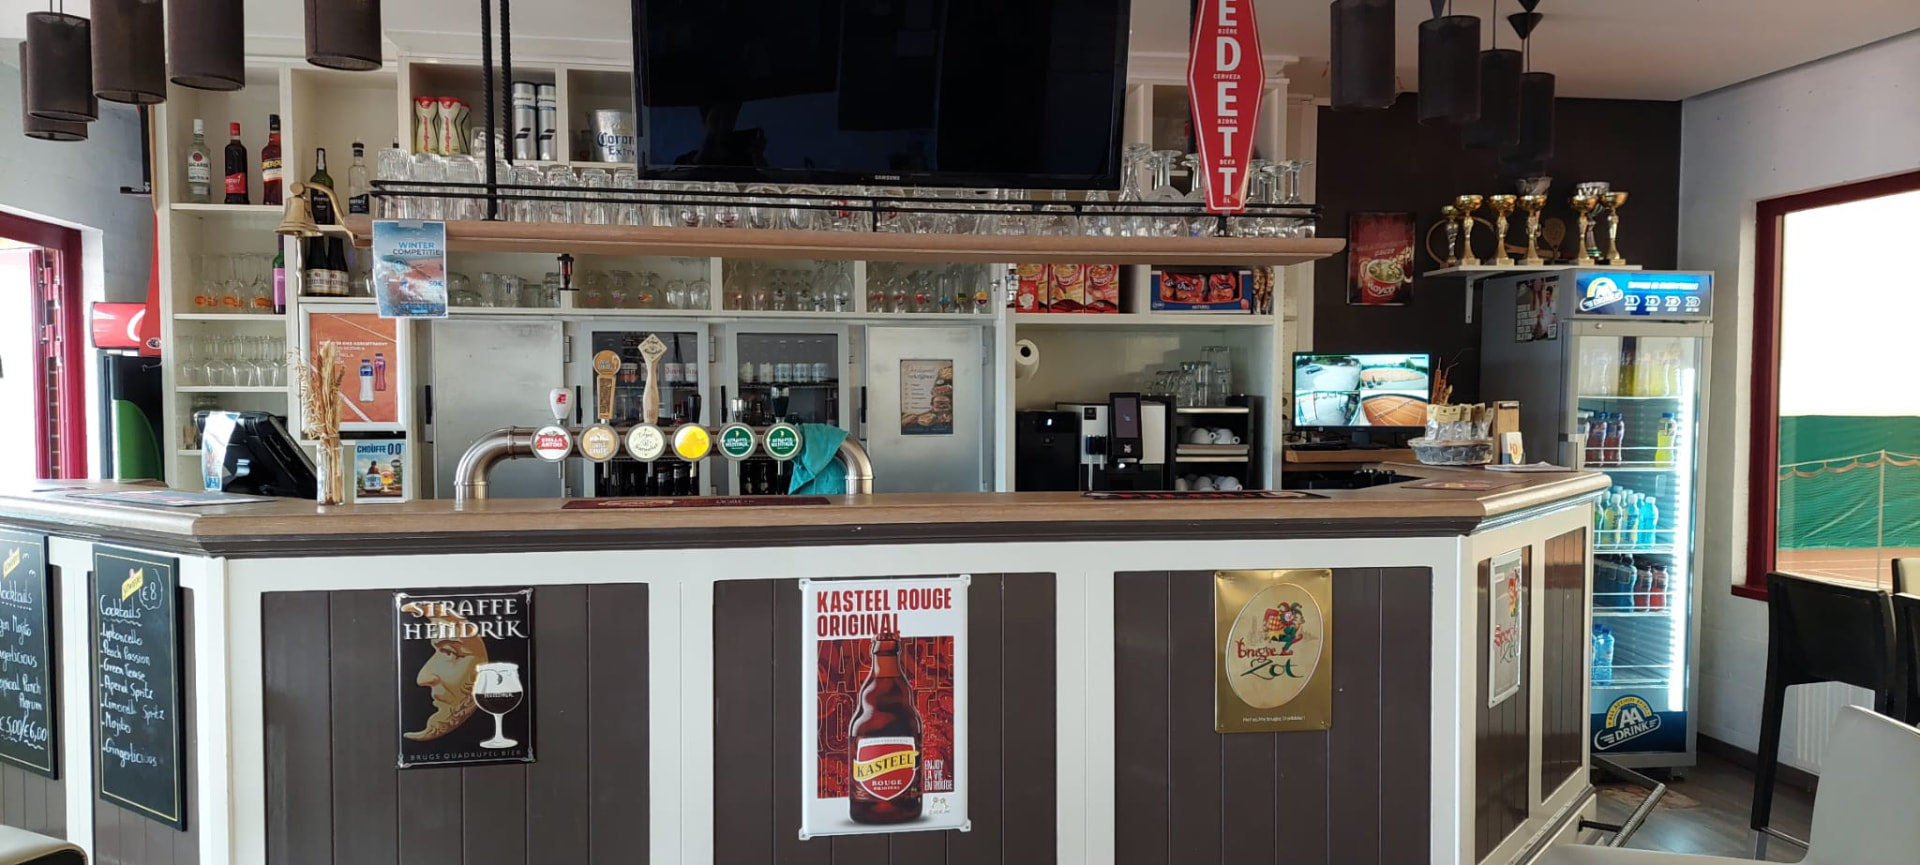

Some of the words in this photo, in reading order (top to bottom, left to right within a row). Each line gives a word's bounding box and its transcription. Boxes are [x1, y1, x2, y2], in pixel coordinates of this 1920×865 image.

[1216, 0, 1242, 196] EDETT
[392, 248, 441, 256] COMPETITIE
[398, 241, 436, 249] WINTER
[0, 579, 33, 605] ocktails
[141, 581, 157, 601] €8
[816, 588, 892, 614] KASTEEL
[896, 587, 952, 611] ROUGE
[100, 594, 142, 619] Cocktails
[412, 599, 518, 619] STRAFFE
[12, 613, 32, 646] Mojito
[816, 612, 900, 638] ORIGINAL
[123, 645, 151, 667] Passion
[1240, 658, 1304, 681] Zot
[22, 673, 42, 696] Punch
[1618, 706, 1645, 730] AA
[1614, 720, 1650, 742] DRINK
[410, 753, 441, 761] BRUGS
[443, 751, 497, 760] QUADRUPEL
[501, 749, 521, 757] BIER
[856, 752, 914, 778] KASTEEL
[924, 759, 944, 771] ENJOY
[871, 779, 903, 788] ROUGE
[924, 770, 933, 781] LA
[934, 769, 944, 781] VIE
[924, 779, 933, 791] EN
[935, 779, 953, 791] ROUGE
